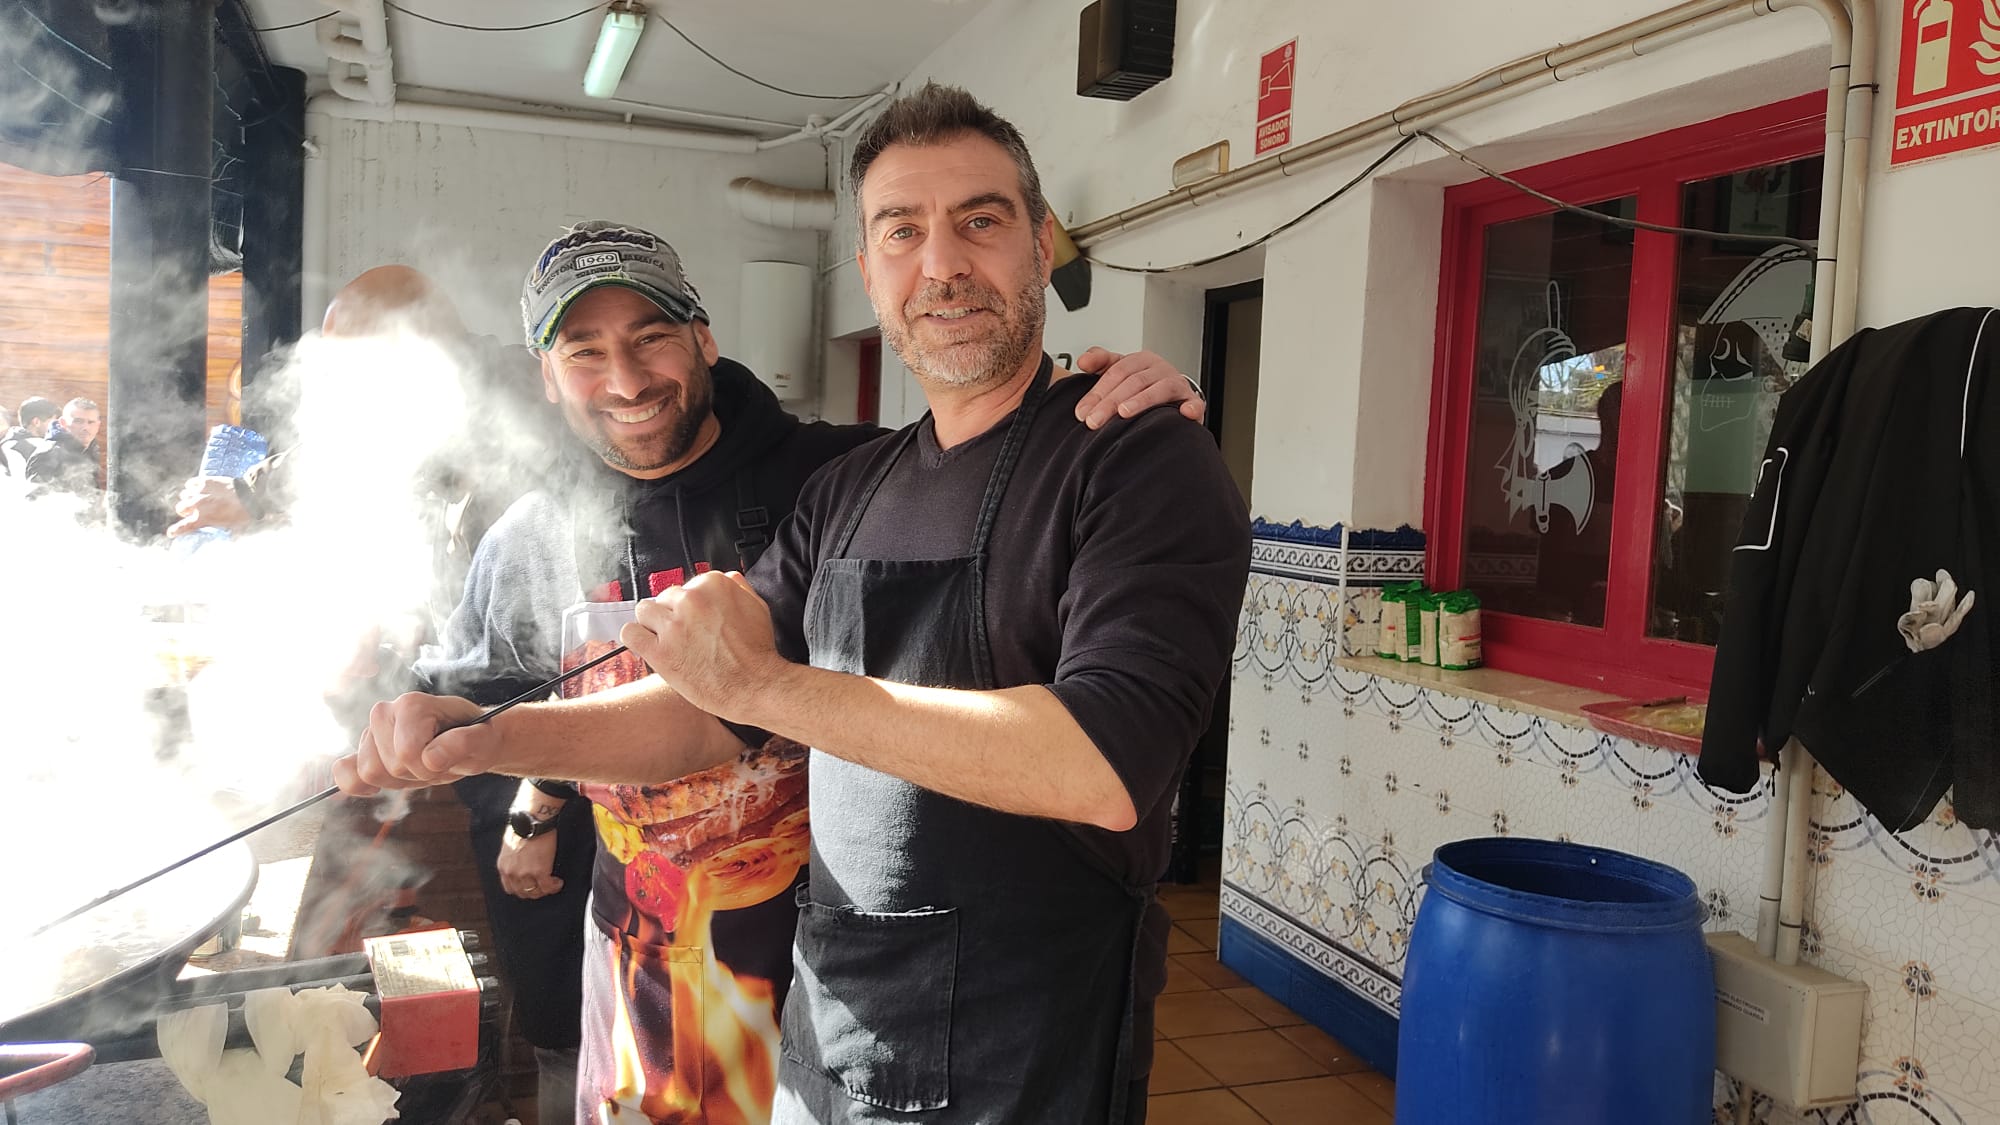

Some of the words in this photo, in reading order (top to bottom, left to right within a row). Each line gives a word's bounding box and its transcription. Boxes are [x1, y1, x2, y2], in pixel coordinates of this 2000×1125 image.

[1258, 117, 1288, 139] AVISADOR
[1895, 106, 2000, 150] EXTINTOR
[1260, 131, 1286, 150] SONORO
[580, 255, 615, 267] 1969
